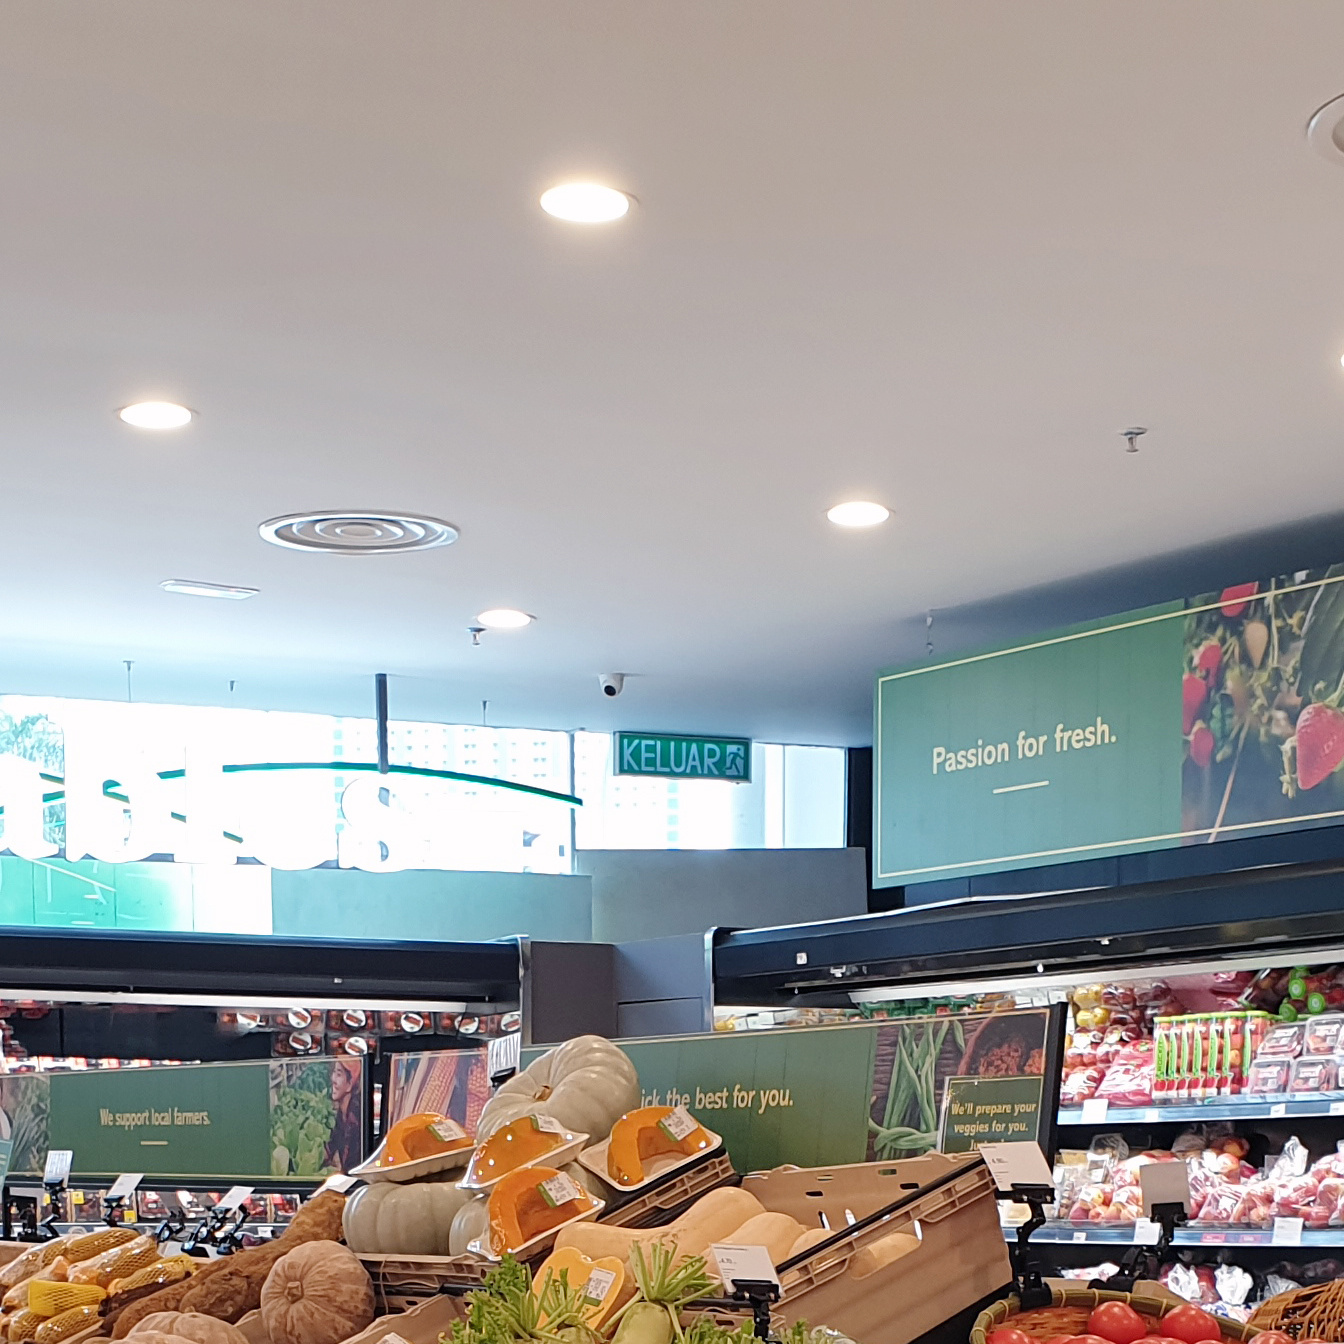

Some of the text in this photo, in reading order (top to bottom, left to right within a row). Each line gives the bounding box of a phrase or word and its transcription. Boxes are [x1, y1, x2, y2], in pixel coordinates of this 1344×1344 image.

[622, 737, 721, 776] KELUAR
[932, 716, 1117, 775] Passion for fresh.
[641, 1084, 794, 1115] ick the best for you.
[951, 1102, 1037, 1117] We'll prepare your
[99, 1107, 212, 1131] We support local farmers.
[953, 1119, 1029, 1136] veggies for you.
